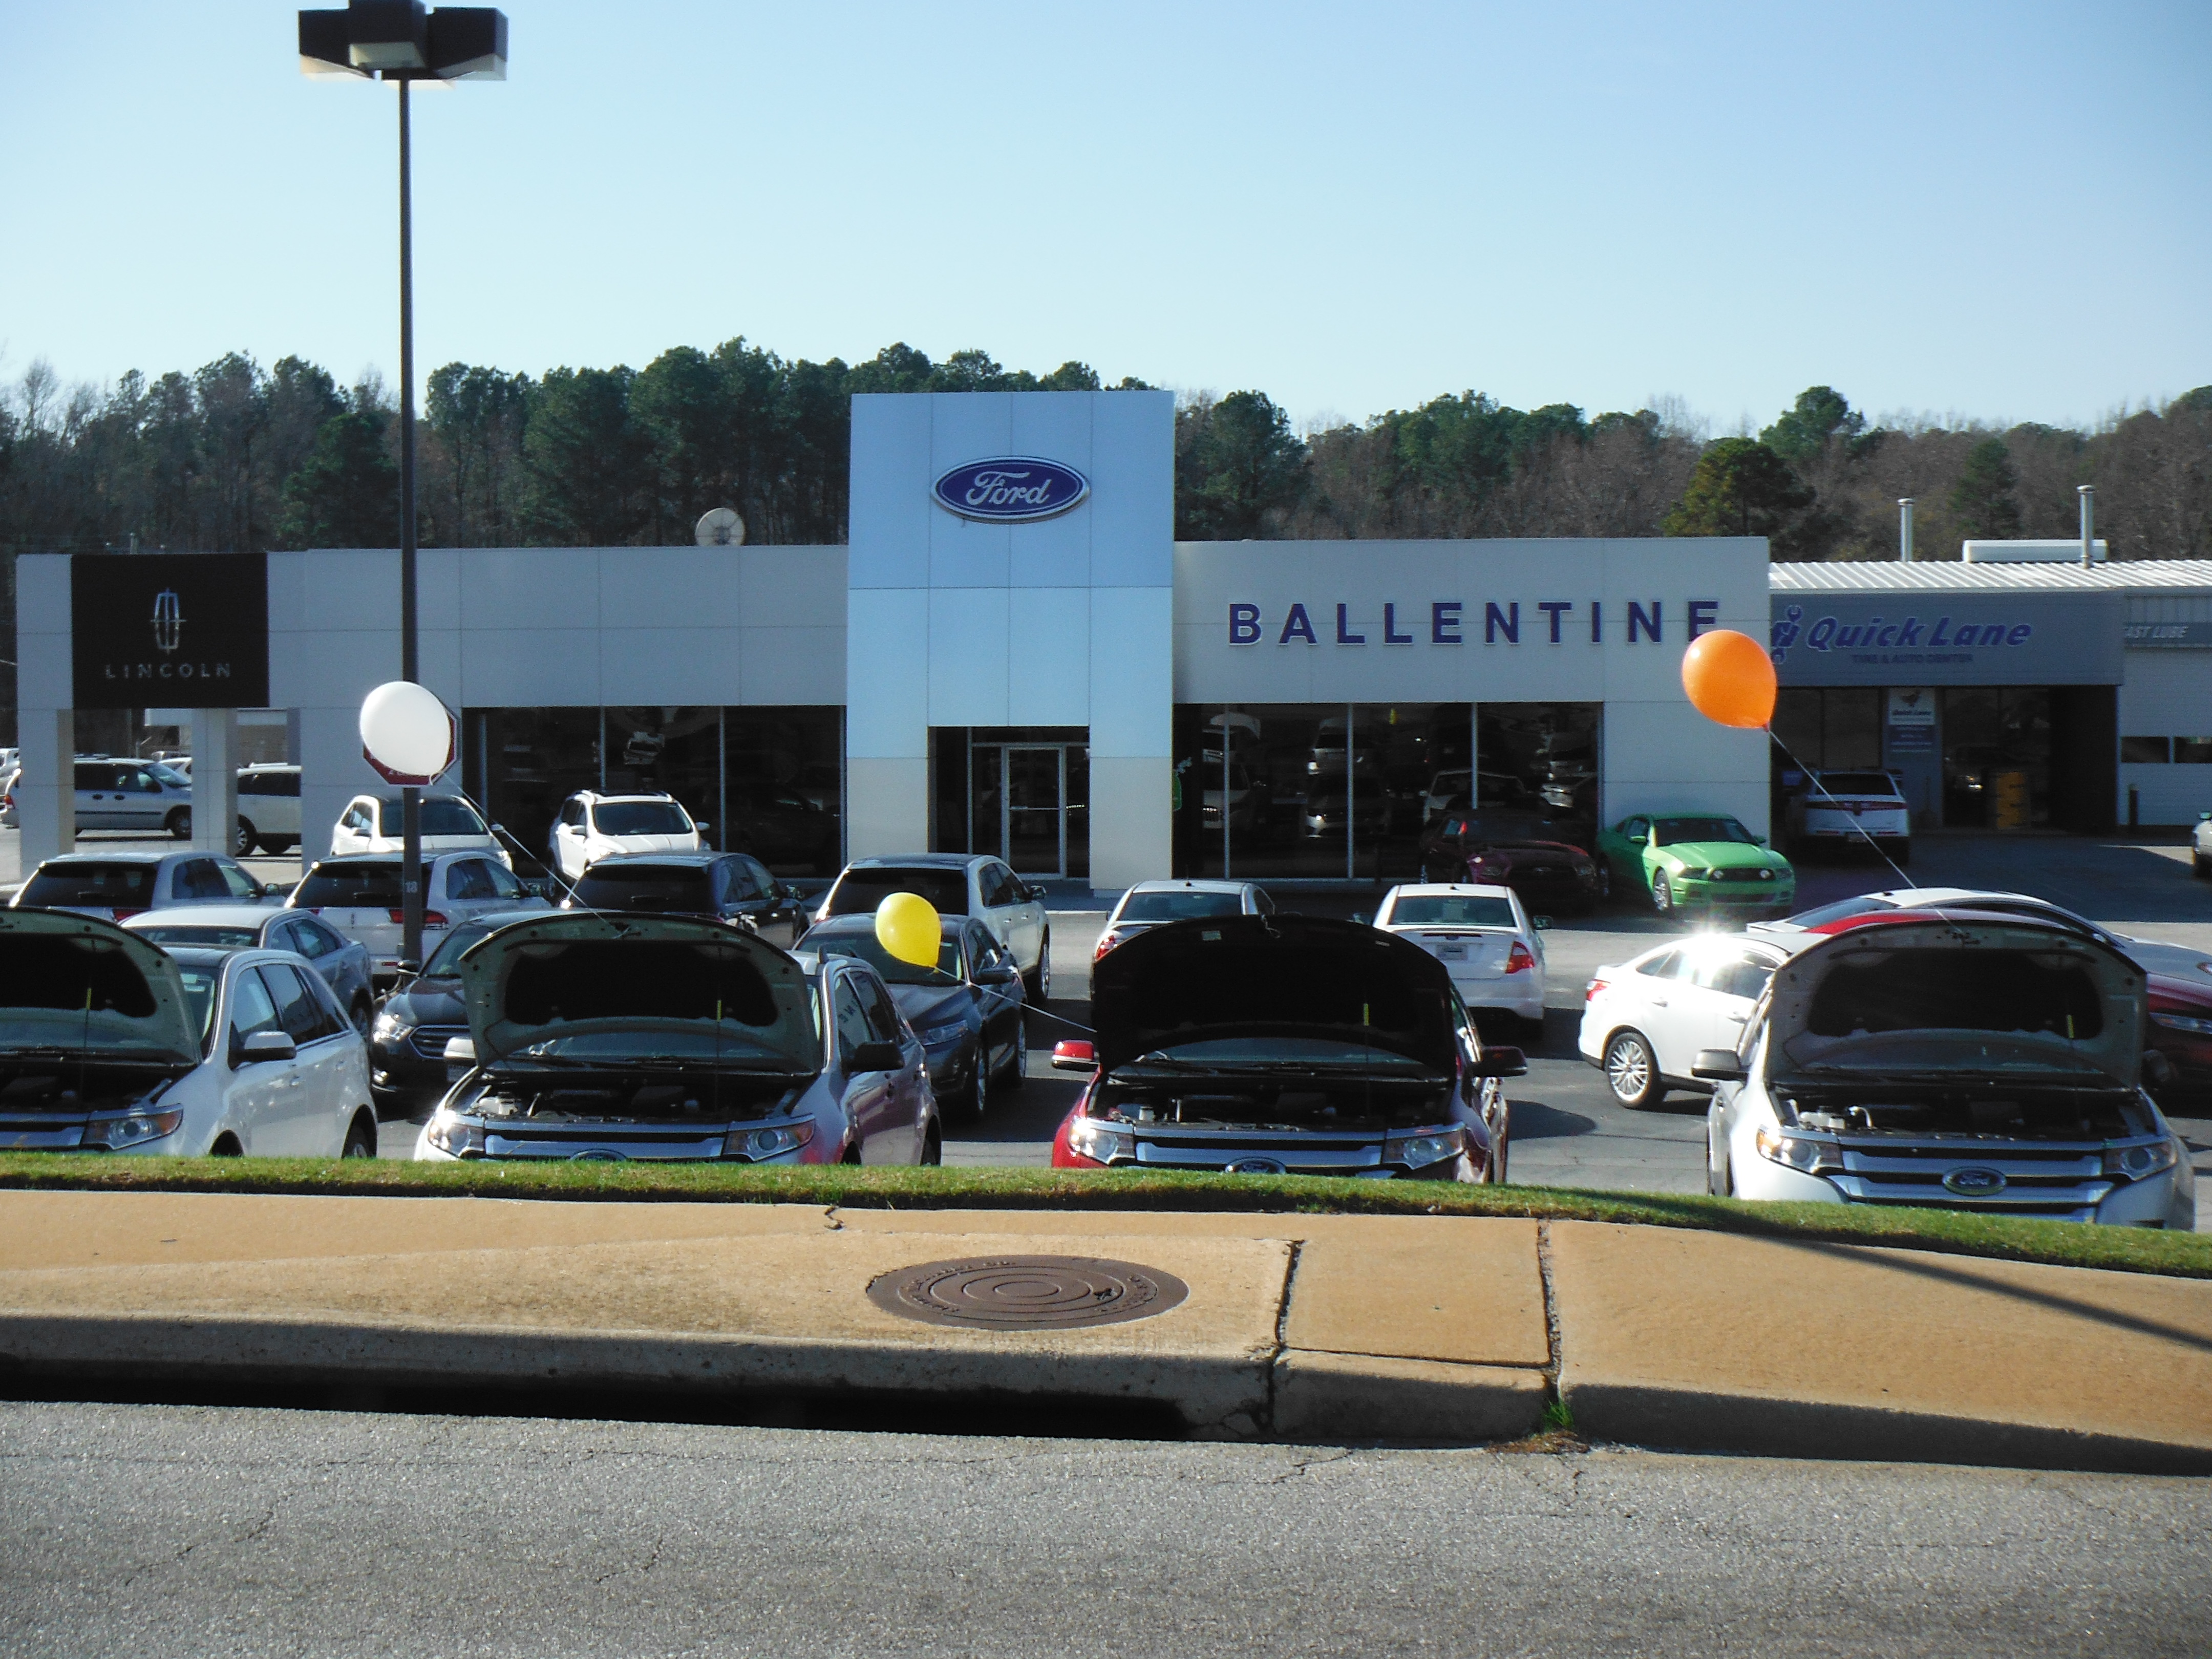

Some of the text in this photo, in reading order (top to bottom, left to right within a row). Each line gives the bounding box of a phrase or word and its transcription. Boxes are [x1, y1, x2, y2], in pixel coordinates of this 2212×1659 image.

[966, 471, 1052, 505] Ford
[1228, 601, 1718, 645] BALLENTINE
[1806, 616, 2032, 652] Quick Lane
[105, 663, 230, 679] LINCOLN
